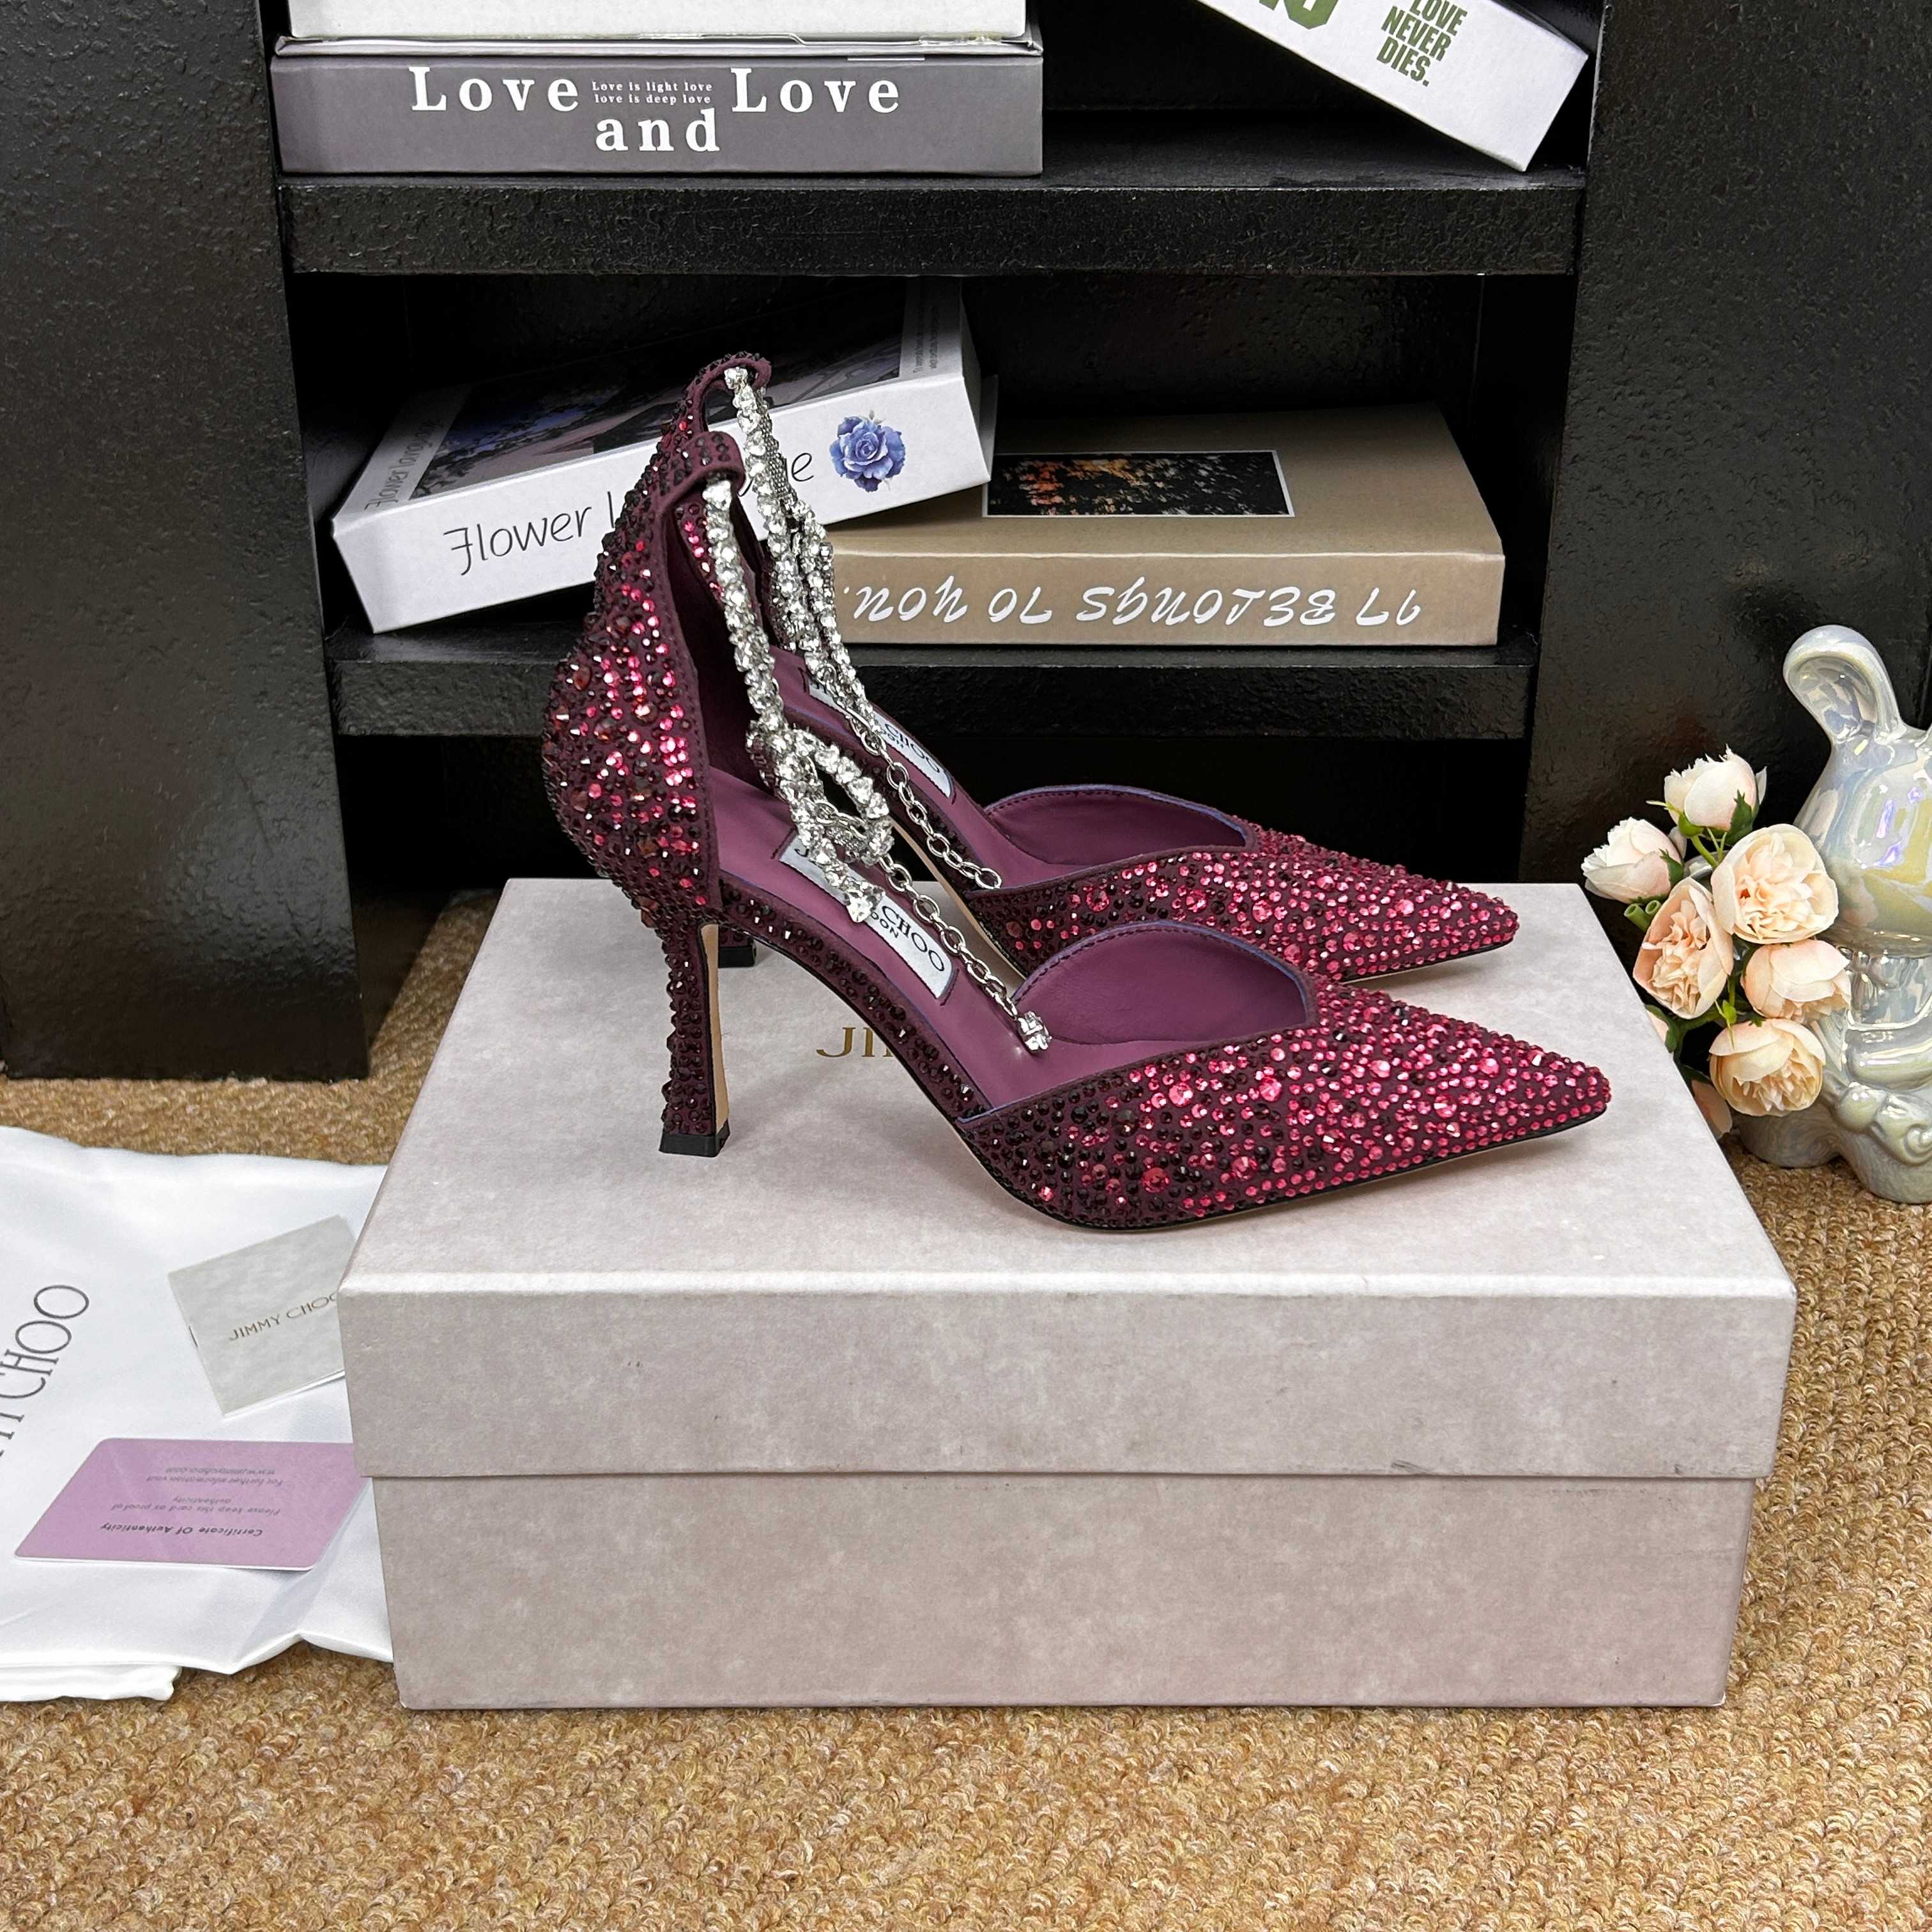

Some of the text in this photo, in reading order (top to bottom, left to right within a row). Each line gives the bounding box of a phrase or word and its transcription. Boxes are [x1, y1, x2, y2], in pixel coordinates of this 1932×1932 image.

[1381, 6, 1452, 61] NEVER
[1409, 0, 1468, 36] LOVE
[1376, 36, 1430, 87] DIES.
[408, 66, 899, 113] Love Love
[592, 81, 712, 93] Love is light love
[595, 94, 711, 105] love is deep love
[595, 107, 720, 152] and
[443, 507, 592, 576] Flower
[843, 576, 1422, 627] IT BELONGS TO YOU.
[882, 905, 945, 972] CHOO
[228, 1312, 280, 1341] JIMMY
[100, 1522, 174, 1533] Authenticity
[198, 1528, 263, 1537] Certificate
